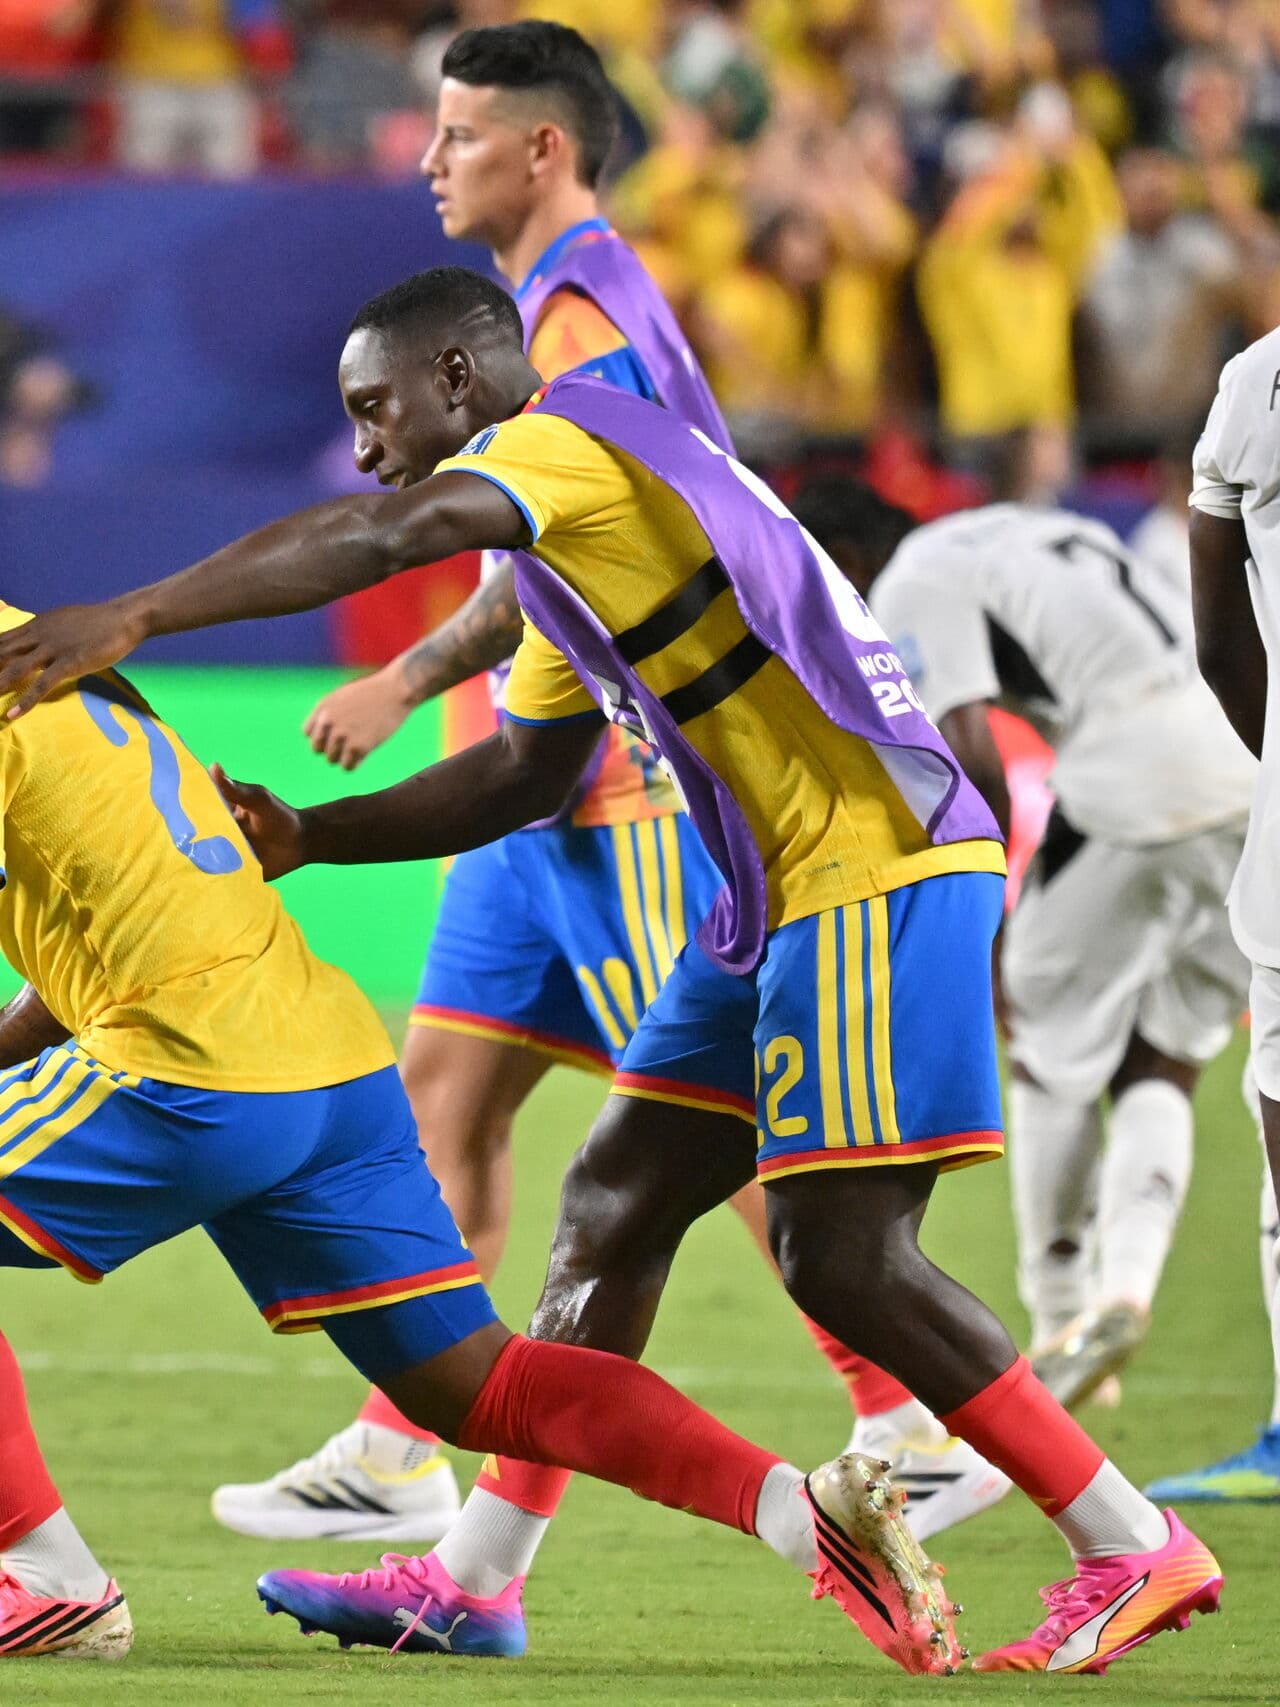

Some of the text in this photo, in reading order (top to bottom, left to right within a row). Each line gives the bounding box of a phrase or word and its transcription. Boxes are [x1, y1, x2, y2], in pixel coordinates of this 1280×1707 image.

[856, 652, 908, 677] WOR
[870, 679, 926, 718] 20
[754, 1035, 809, 1150] 2
